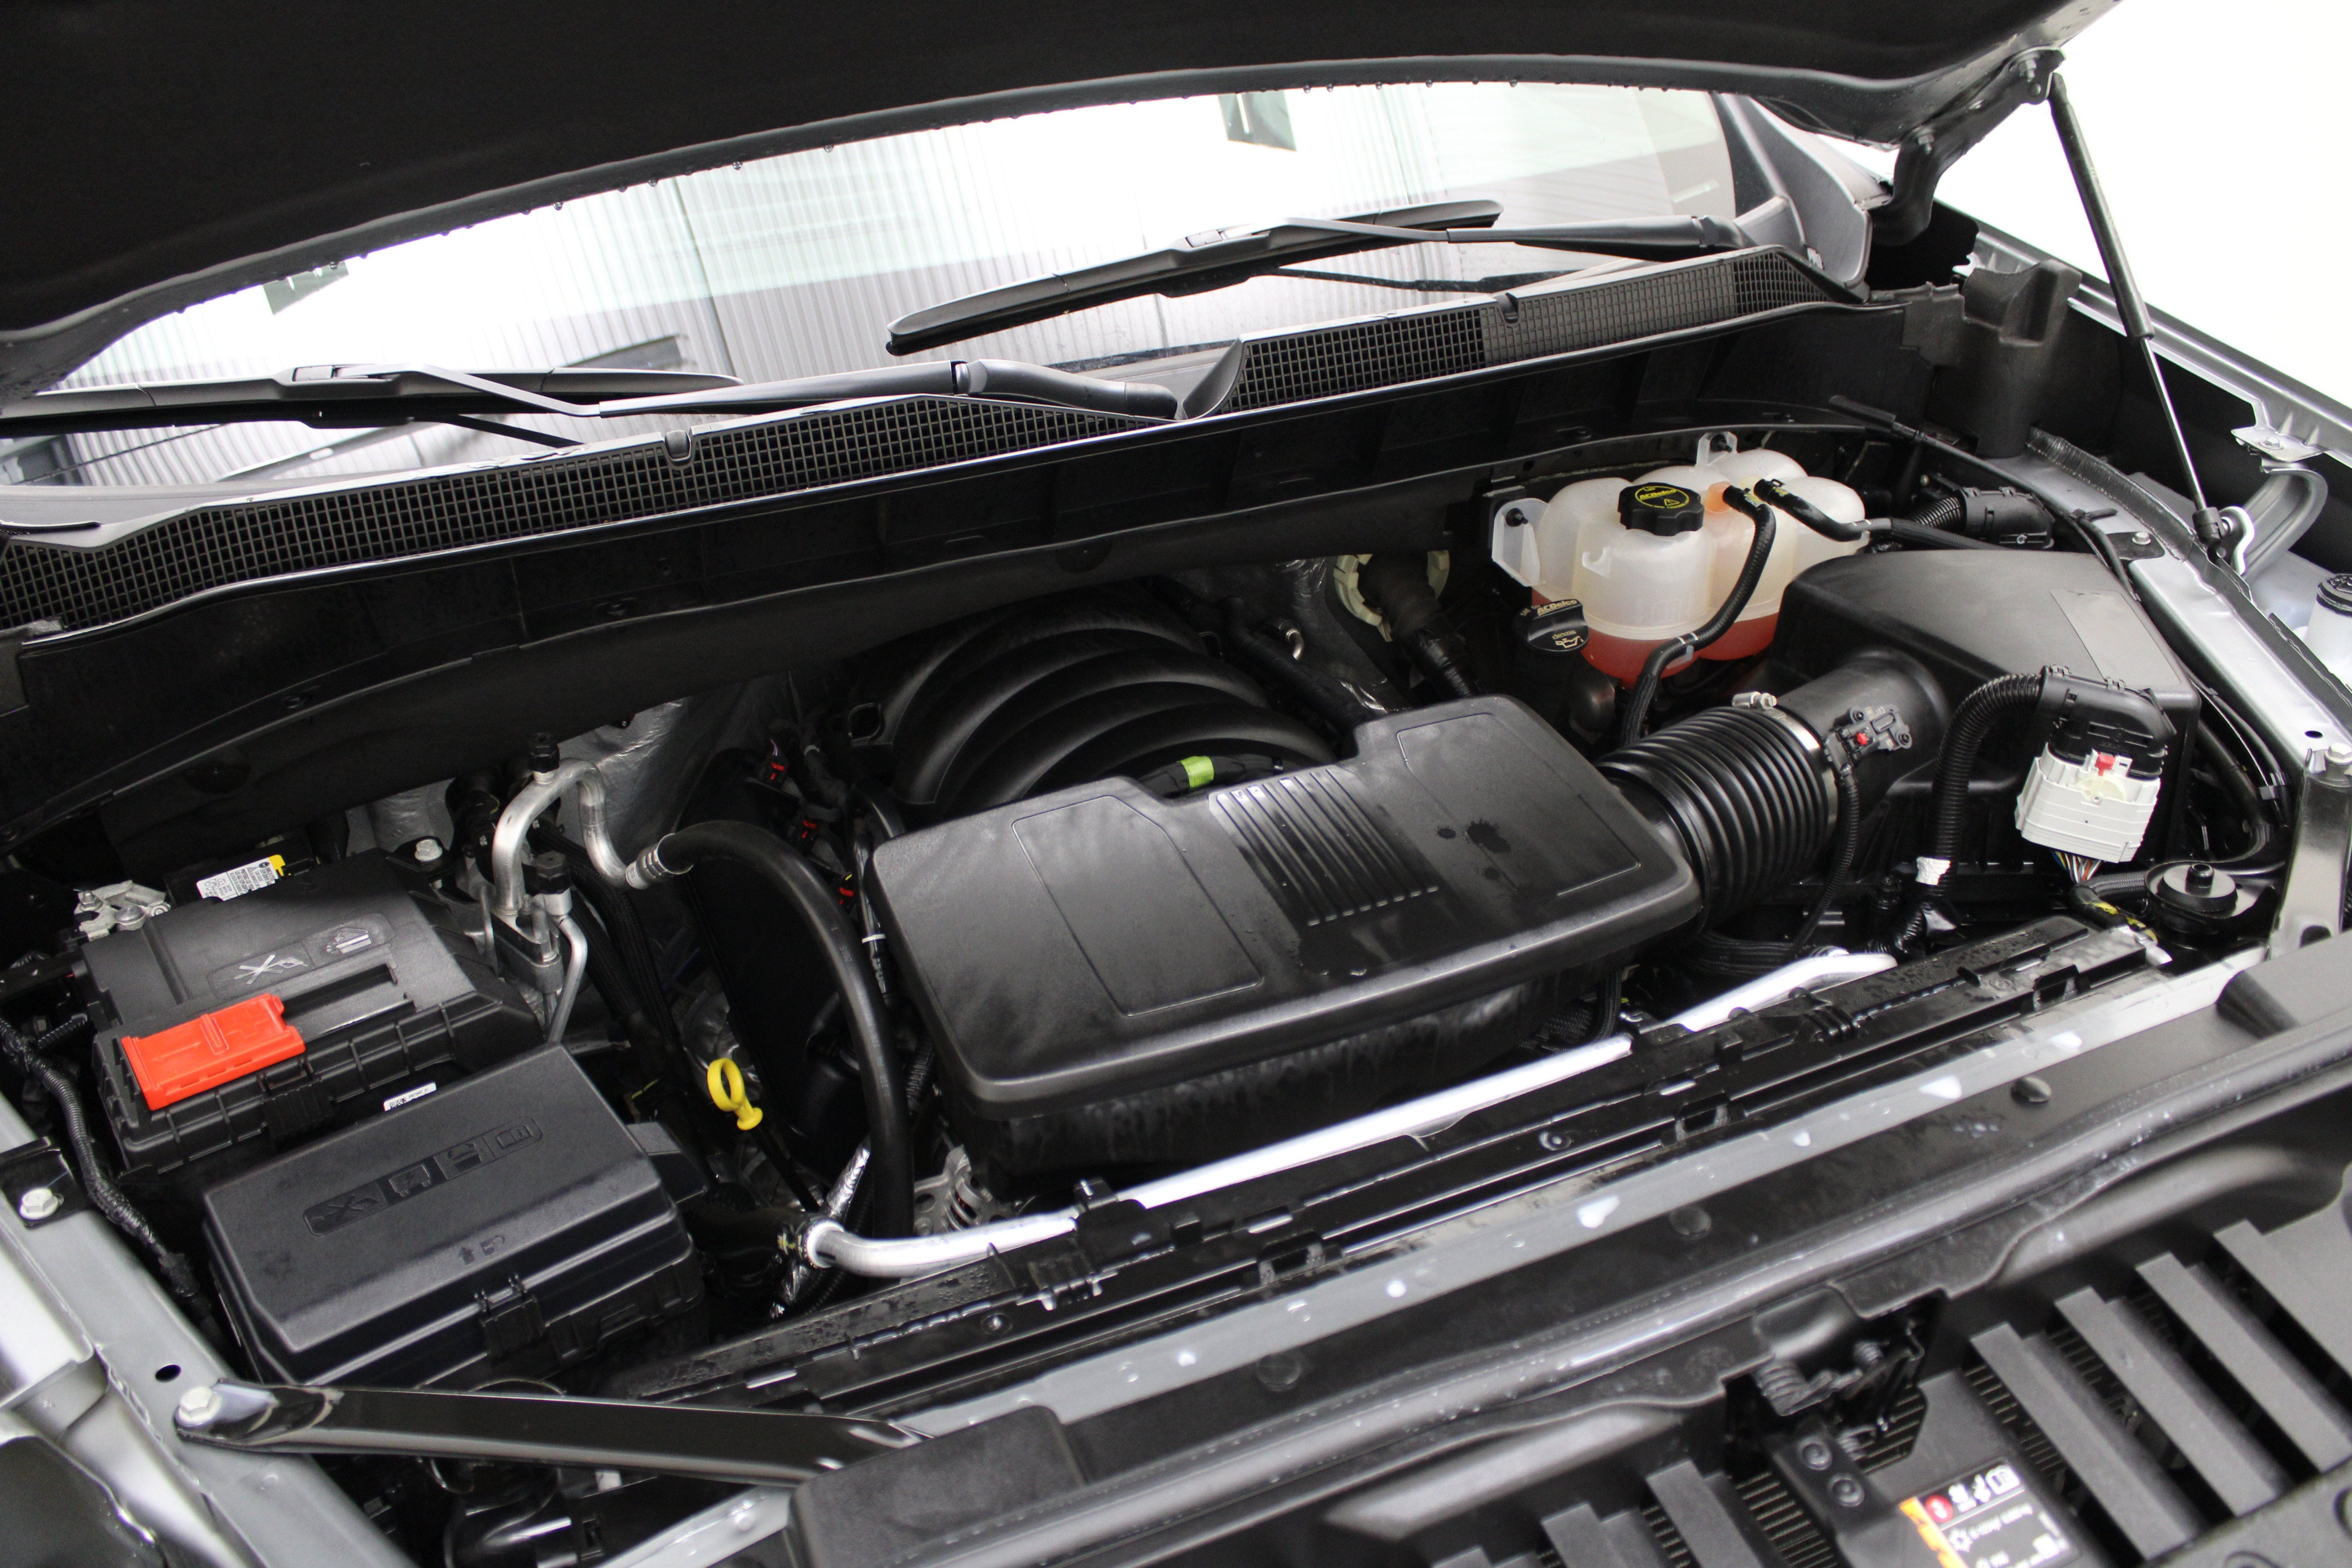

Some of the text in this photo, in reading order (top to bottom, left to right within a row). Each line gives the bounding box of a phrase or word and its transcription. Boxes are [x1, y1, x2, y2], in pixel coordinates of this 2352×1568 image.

[1640, 490, 1677, 501] ACDelco
[1537, 599, 1577, 616] ACDelco
[1552, 630, 1577, 639] dexos
